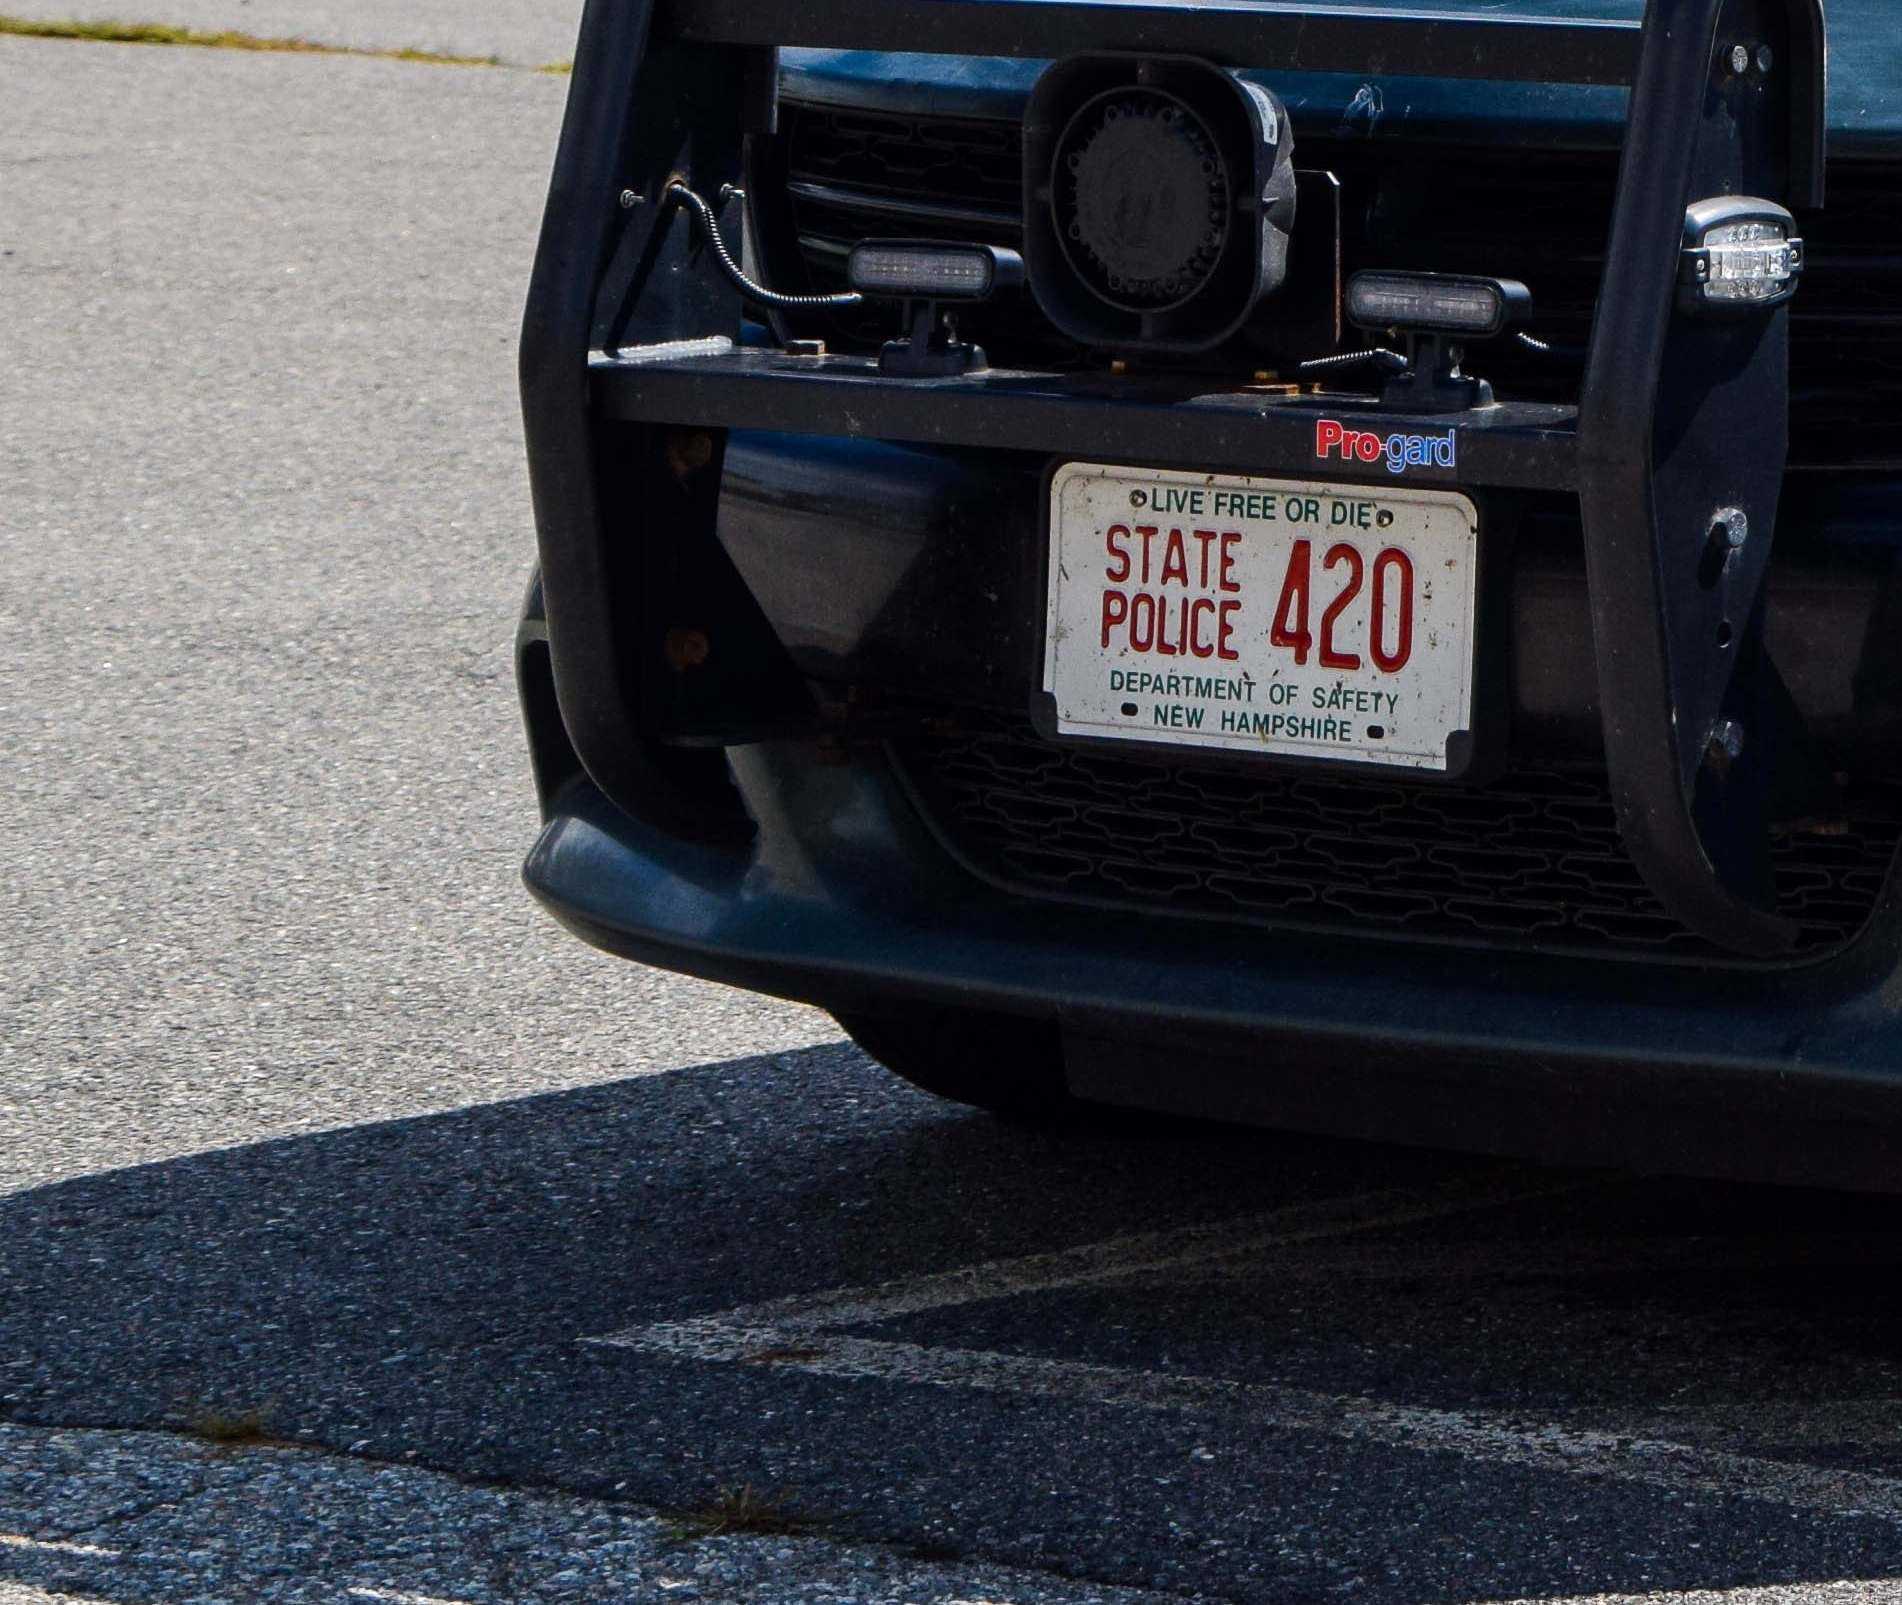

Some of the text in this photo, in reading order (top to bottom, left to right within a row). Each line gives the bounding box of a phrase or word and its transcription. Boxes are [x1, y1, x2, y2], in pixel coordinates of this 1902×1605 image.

[1316, 419, 1455, 472] Pro-gard
[1151, 487, 1372, 528] LIVE FREE OR DIE
[1105, 524, 1242, 593] STATE
[1102, 589, 1242, 661] POLICE
[1270, 539, 1414, 674] 420
[1110, 669, 1400, 715] DEPARTMENT OF SAFETY
[1153, 703, 1353, 742] NEW HAMPSHIRE
